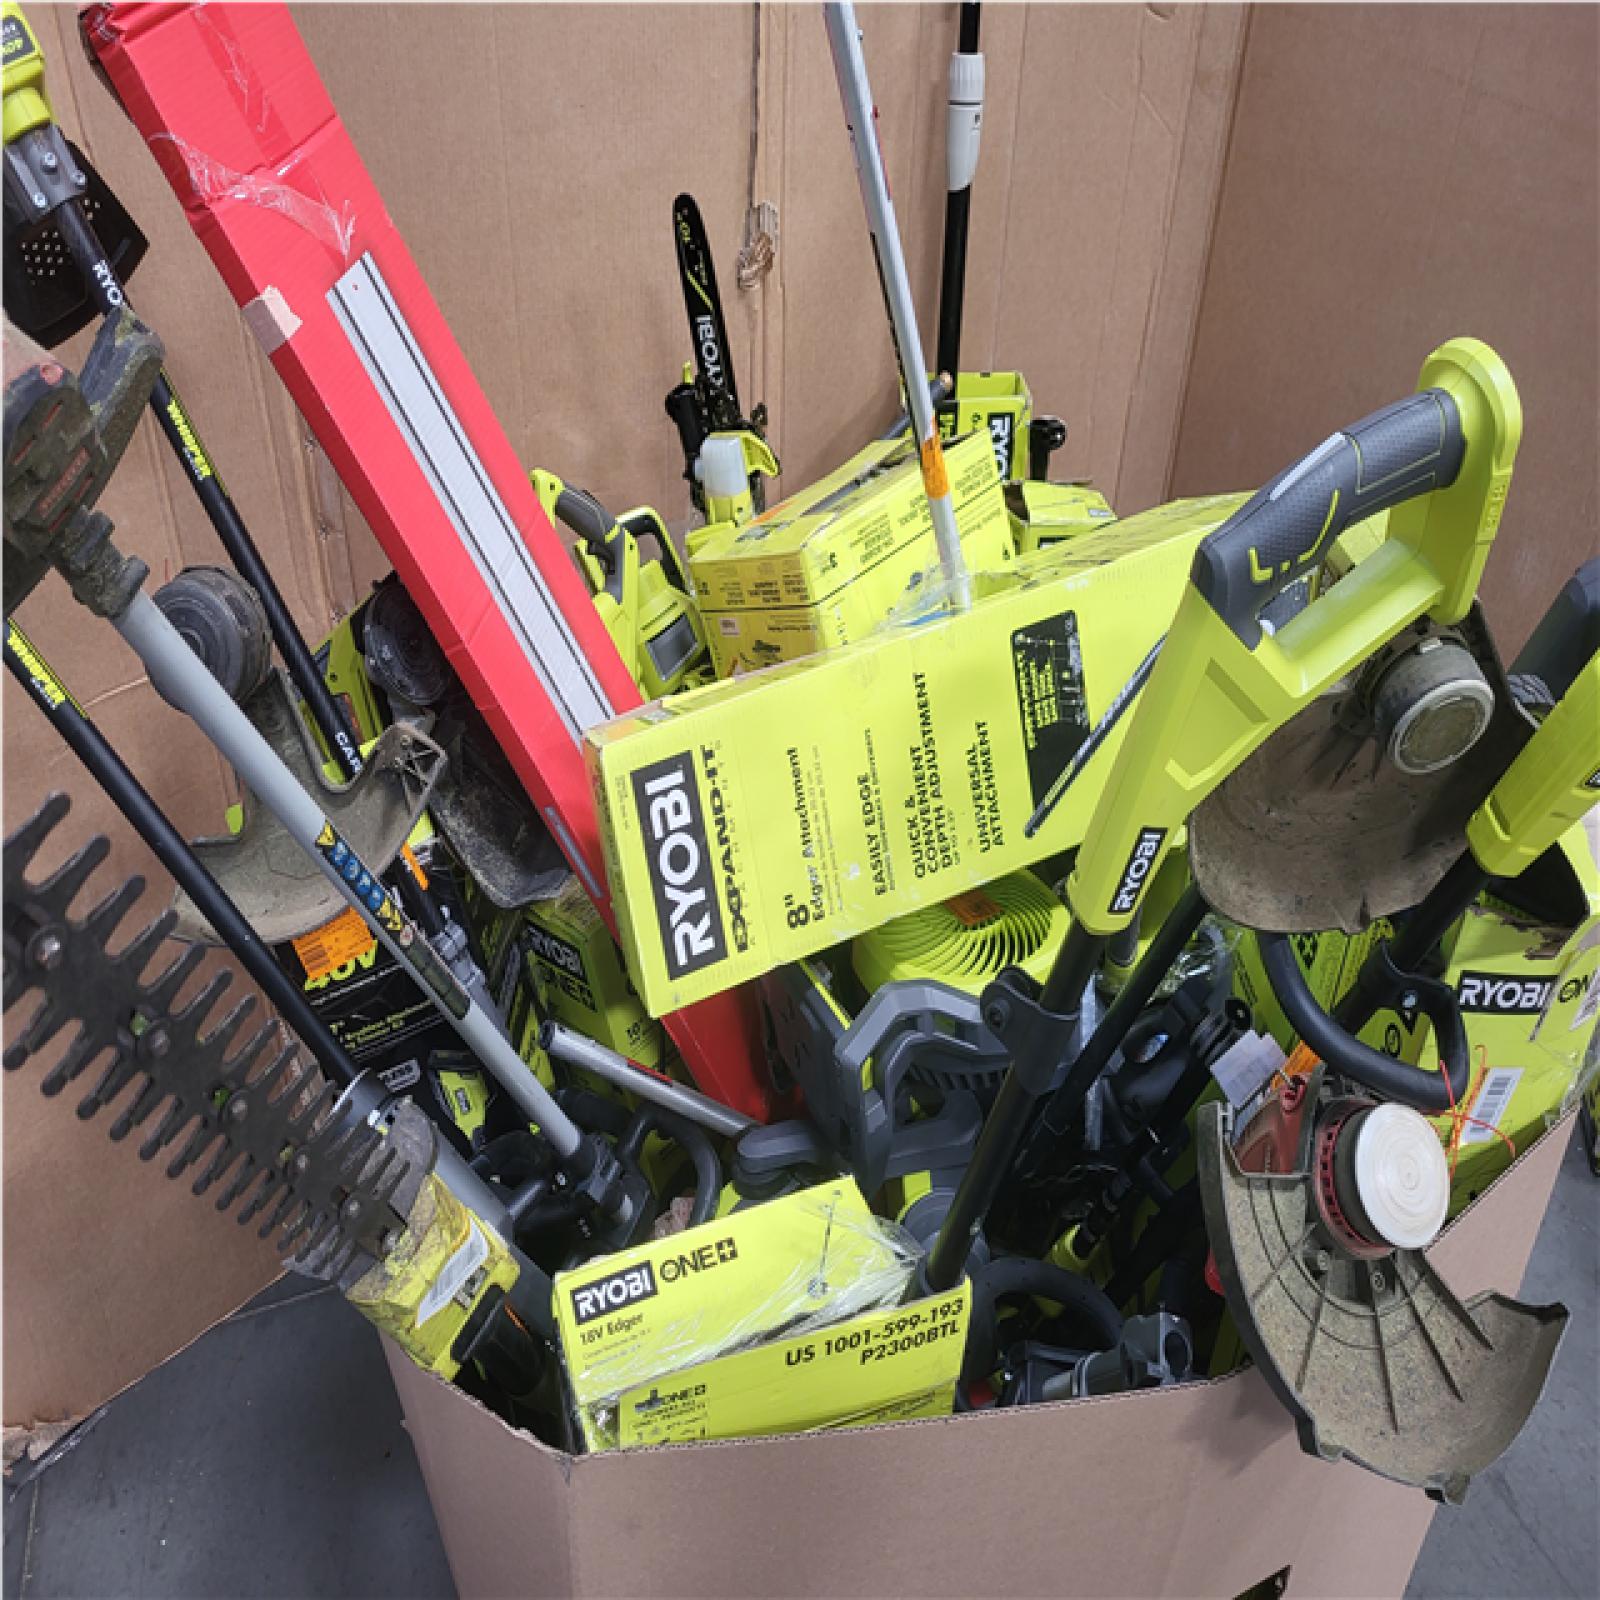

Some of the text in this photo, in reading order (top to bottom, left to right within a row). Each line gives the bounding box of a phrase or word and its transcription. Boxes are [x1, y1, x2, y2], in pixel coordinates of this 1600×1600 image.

[92, 260, 124, 305] RYO
[991, 415, 1011, 482] RYO
[787, 747, 815, 858] Attachment
[857, 772, 876, 827] EDGE
[913, 672, 952, 868] DEPTH ADJUSTMENT
[966, 743, 991, 853] UNIVERSAL
[975, 720, 1005, 845] ATTACHMENT
[910, 745, 938, 873] CONVENIENT
[643, 769, 717, 967] RYOBI
[866, 834, 888, 896] EASILY
[907, 814, 926, 878] QUICK
[1112, 832, 1160, 911] RYOBI
[1460, 977, 1551, 1008] RYOBI
[575, 1267, 652, 1317] RYOBI
[580, 1313, 643, 1345] 18V Edger
[785, 1297, 963, 1366] US 1001-599-193
[860, 1320, 960, 1366] P2300BTL
